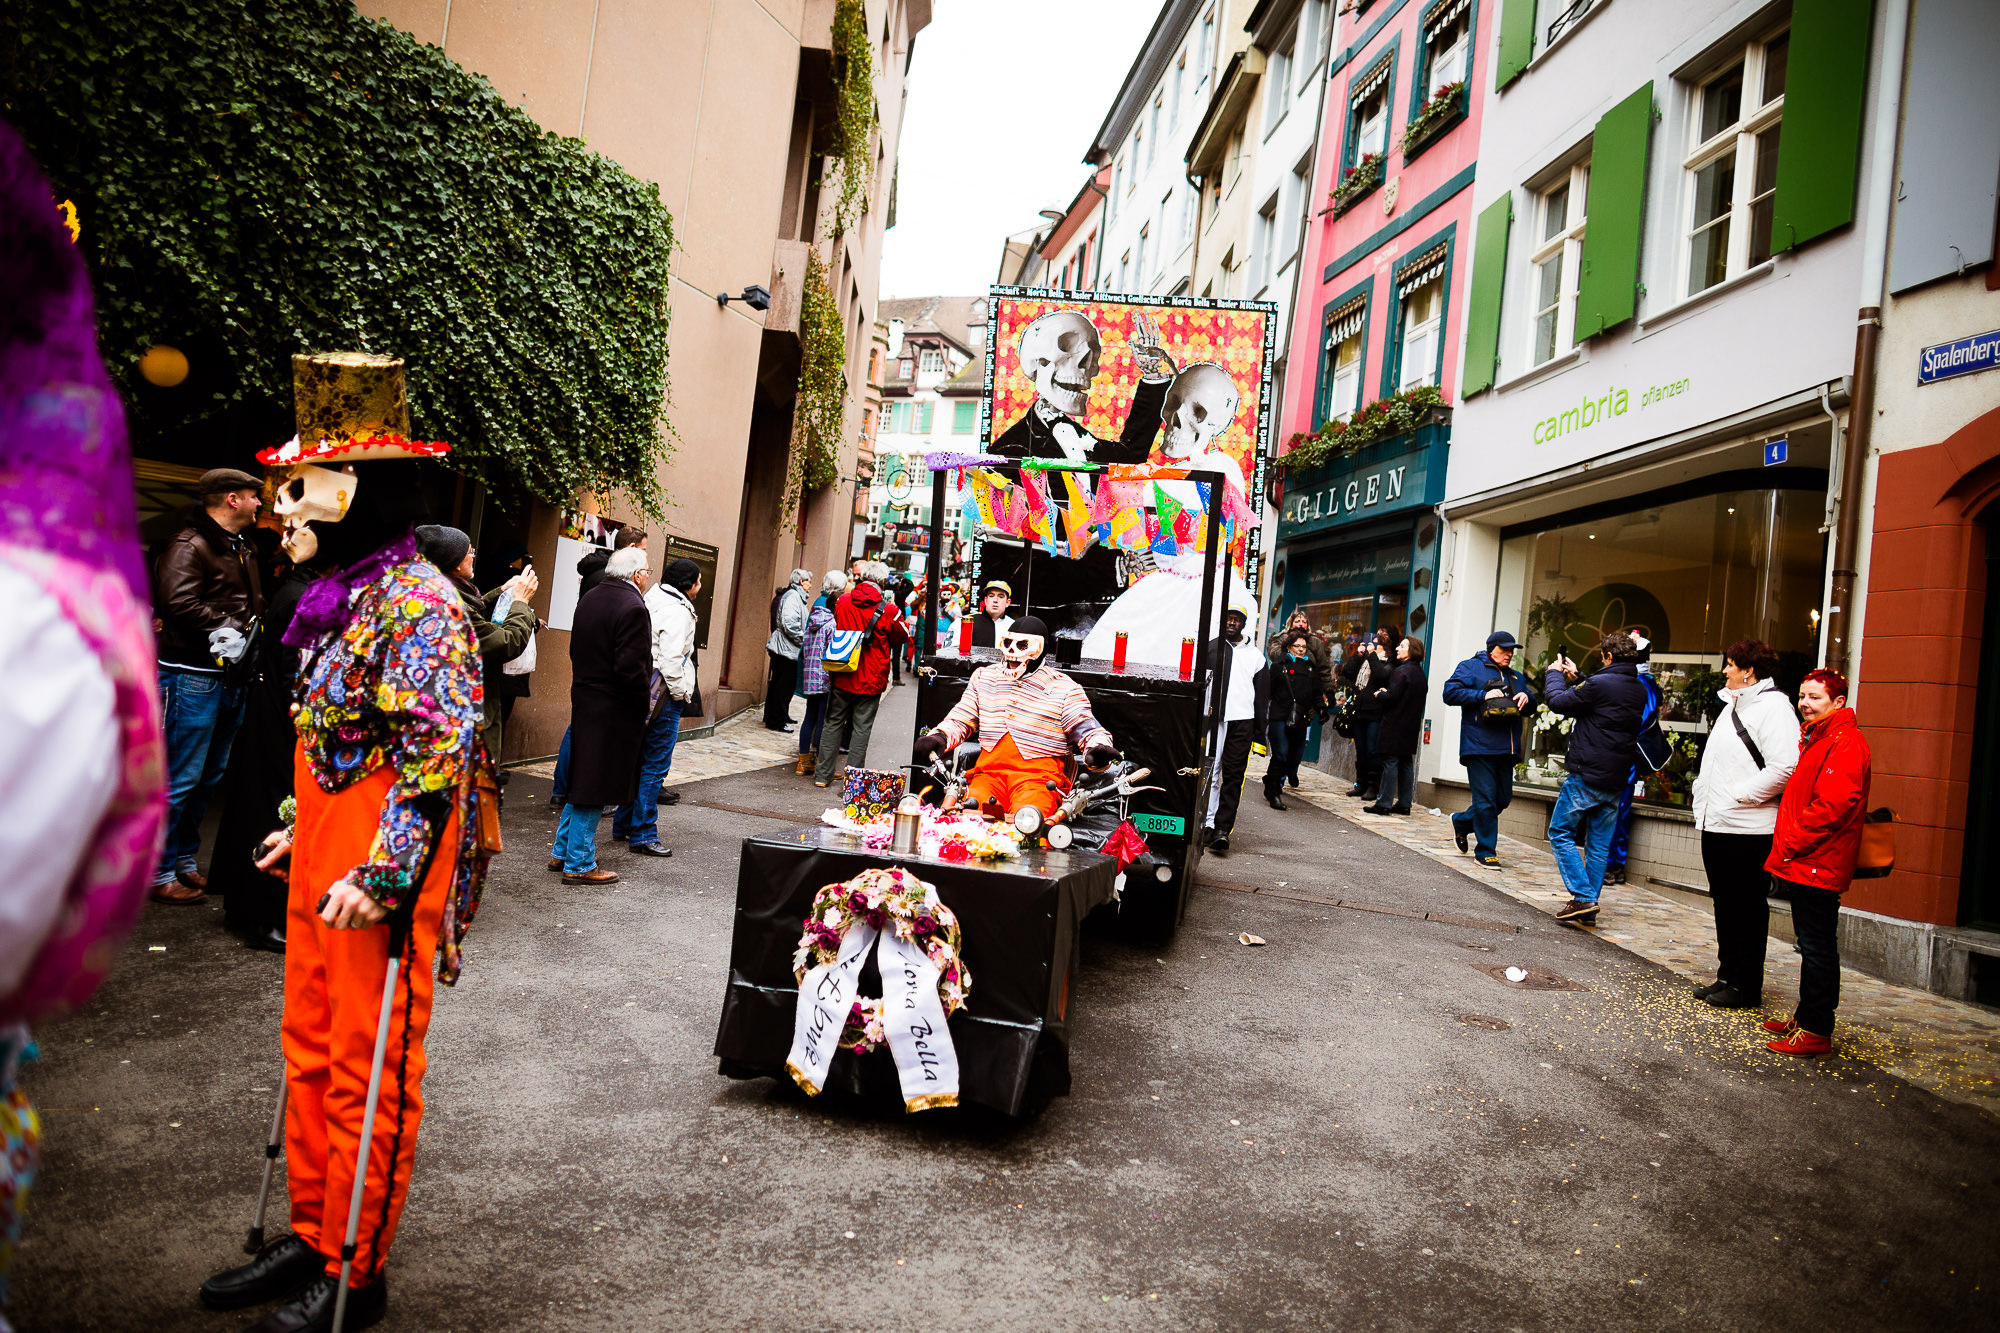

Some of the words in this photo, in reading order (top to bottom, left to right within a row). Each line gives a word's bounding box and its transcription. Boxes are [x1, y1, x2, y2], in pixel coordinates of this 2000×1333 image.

[1048, 288, 1065, 299] Bella
[1071, 290, 1092, 300] Basler
[1171, 296, 1192, 306] Morta
[1193, 297, 1210, 308] Bella
[1217, 299, 1239, 309] Basler
[1261, 383, 1271, 405] Basler
[982, 397, 992, 418] Morta
[1533, 386, 1629, 445] cambria
[1641, 377, 1690, 411] pflanzen
[981, 418, 991, 435] Bella
[1259, 410, 1269, 428] Bella
[1257, 428, 1268, 450] Morta
[1771, 445, 1778, 460] 4
[1297, 466, 1406, 524] GILGEN
[1250, 528, 1260, 551] Basler
[973, 541, 983, 561] Morta
[972, 562, 982, 579] Bella
[1249, 557, 1258, 574] Bella
[970, 585, 980, 606] Basler
[1148, 817, 1177, 832] 8895
[910, 1016, 939, 1082] Bella
